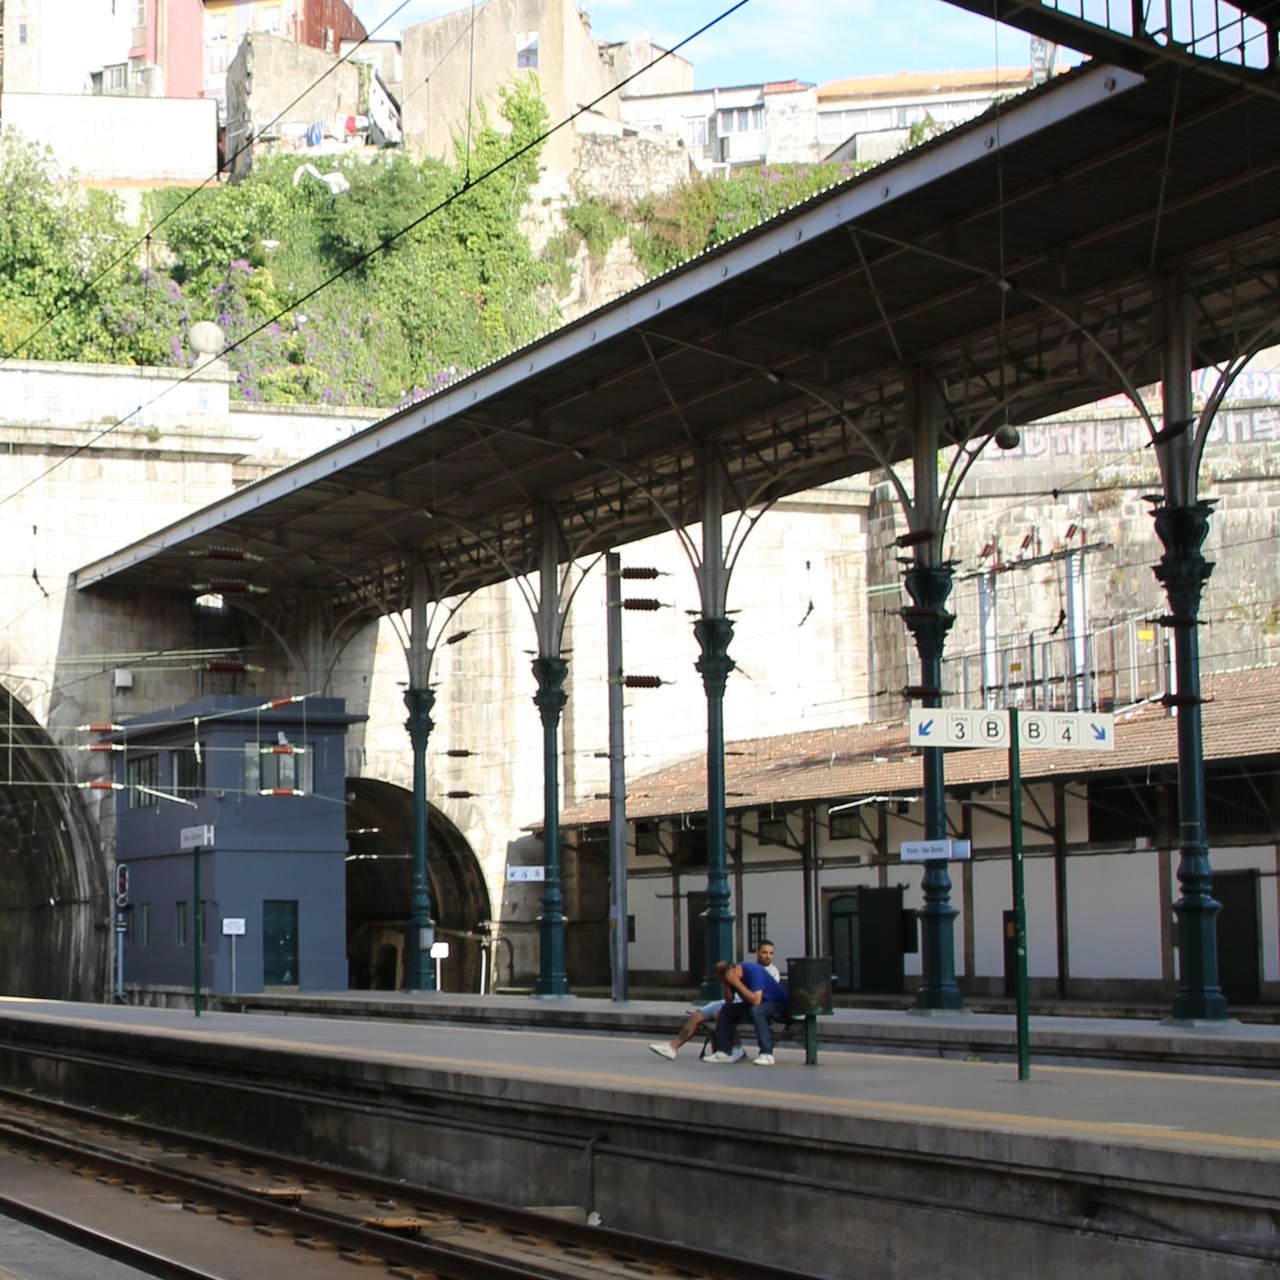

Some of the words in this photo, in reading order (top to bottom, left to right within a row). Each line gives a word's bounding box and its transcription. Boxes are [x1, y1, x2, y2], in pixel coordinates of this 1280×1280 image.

[954, 723, 965, 739] 3
[986, 723, 999, 738] B
[1028, 723, 1041, 738] B
[1061, 726, 1072, 742] 4
